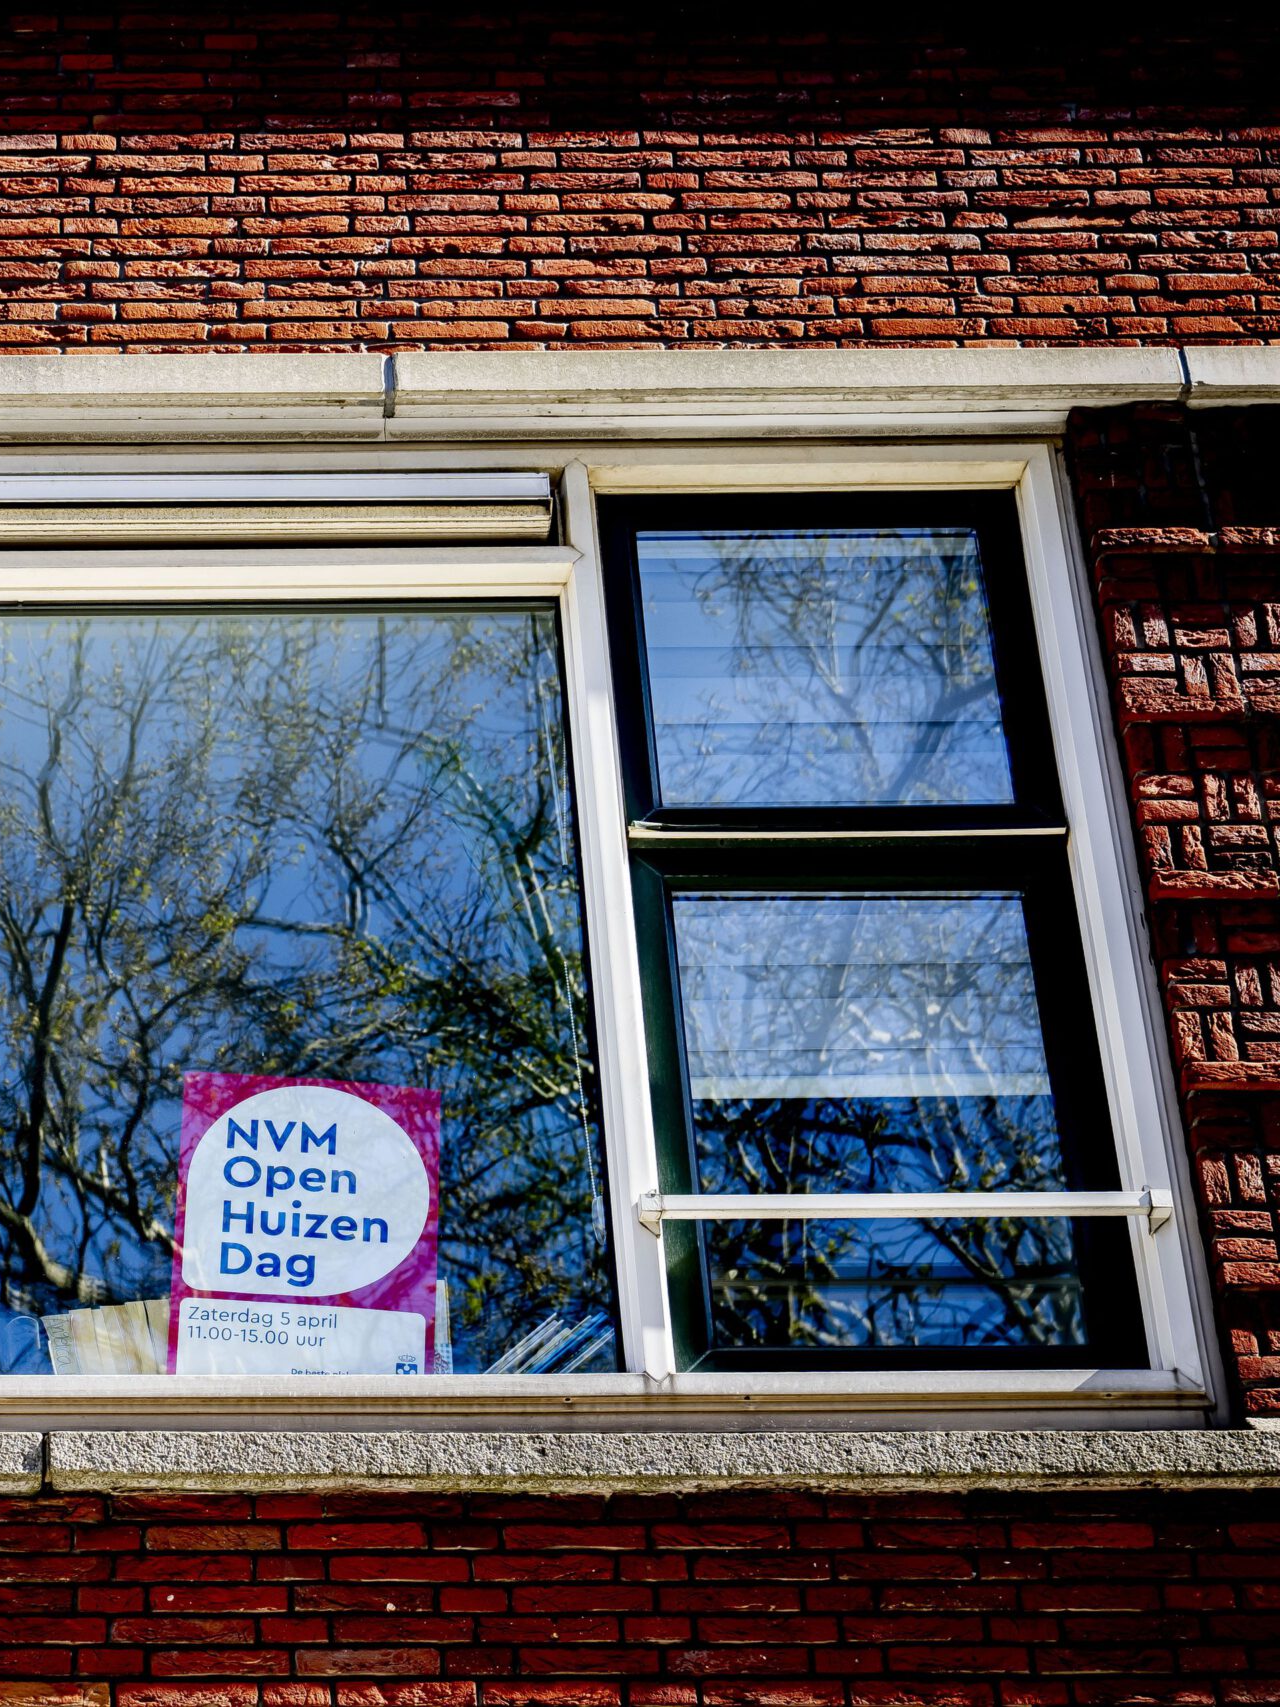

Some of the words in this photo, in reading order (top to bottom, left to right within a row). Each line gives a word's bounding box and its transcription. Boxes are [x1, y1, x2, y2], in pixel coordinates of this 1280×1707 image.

[226, 1117, 337, 1155] NVM
[223, 1155, 357, 1198] Open
[221, 1199, 389, 1244] Huizen
[220, 1241, 316, 1287] Dag
[187, 1325, 289, 1345] 11.00-15.00
[296, 1335, 326, 1347] uur
[188, 1305, 273, 1328] Zaterdag
[280, 1311, 291, 1326] 5
[297, 1313, 338, 1330] april
